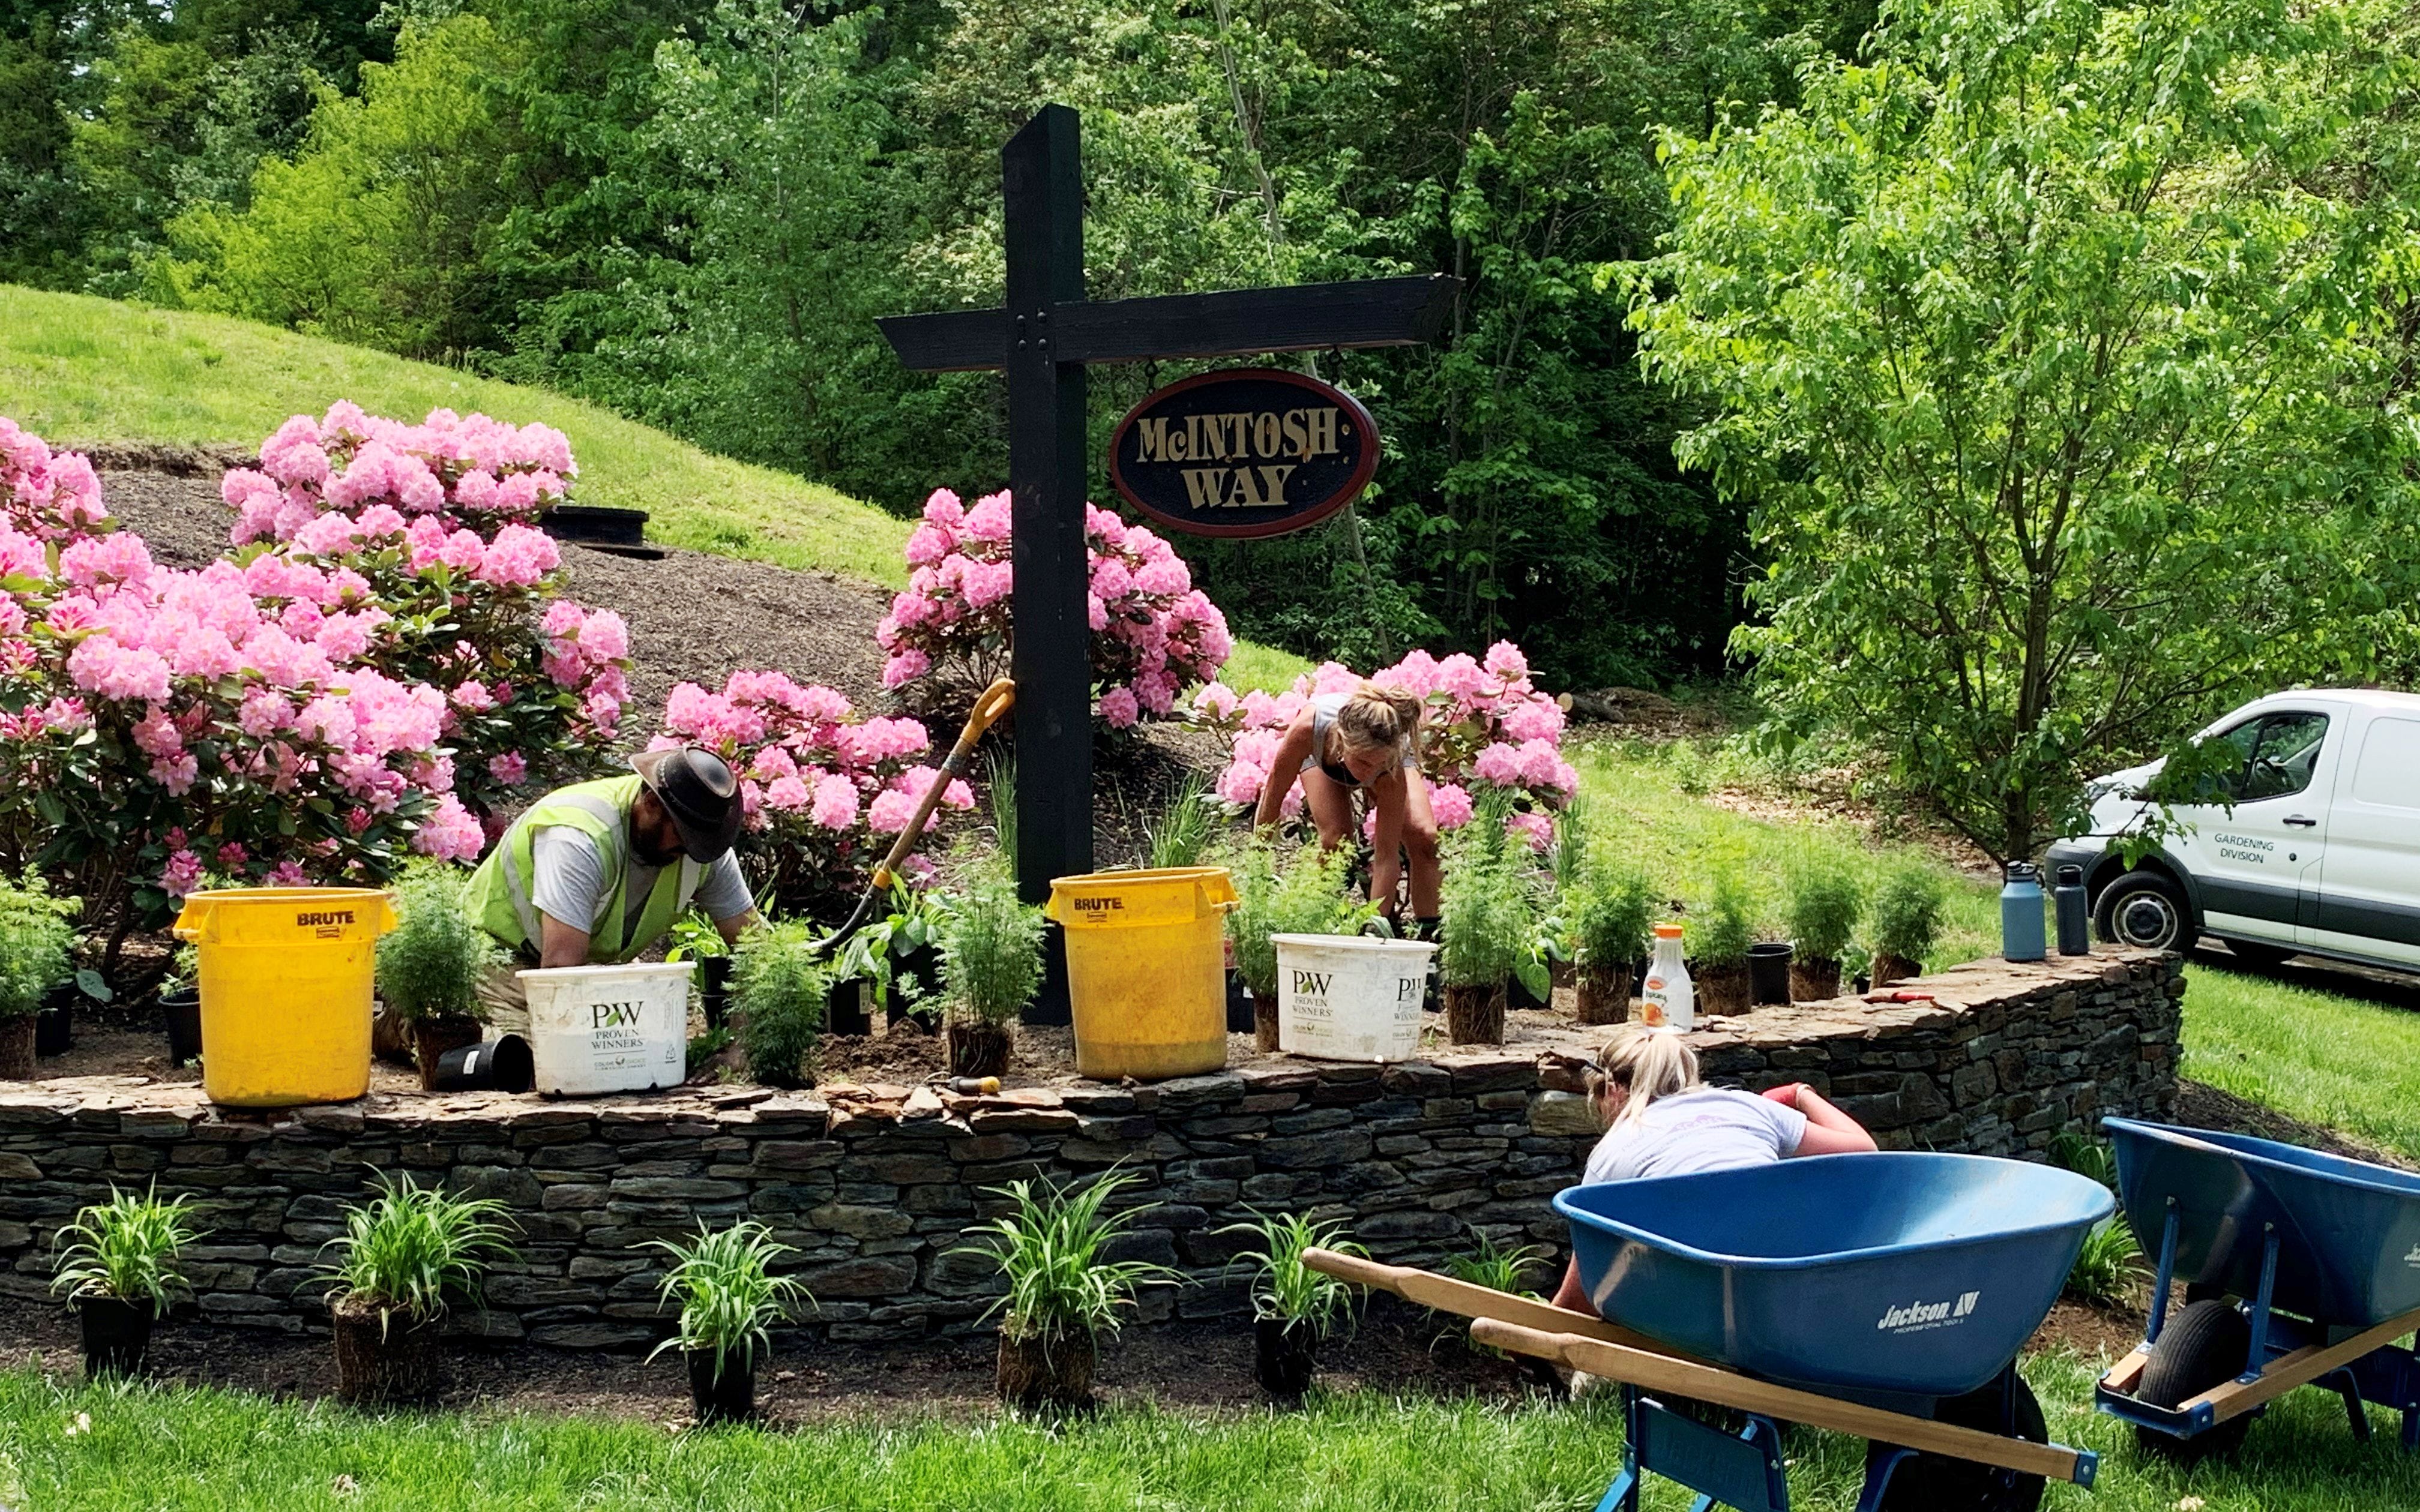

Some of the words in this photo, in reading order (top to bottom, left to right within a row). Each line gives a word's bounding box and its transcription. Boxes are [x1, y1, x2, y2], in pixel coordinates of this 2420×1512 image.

[1136, 407, 1340, 463] McINTOSH
[1179, 464, 1297, 509] WAY
[2215, 833, 2274, 851] GARDENING
[2220, 848, 2264, 863] DIVISION
[1074, 896, 1124, 910] BRUTE
[297, 910, 355, 926] BRUTE
[1292, 970, 1333, 996] PW
[1295, 996, 1328, 1007] PROVEN
[589, 1001, 644, 1029] PW
[1292, 1005, 1331, 1017] WINNERS
[596, 1029, 639, 1039] PROVEN
[591, 1039, 643, 1049] WINNERS
[1877, 1300, 1951, 1330] Jackson
